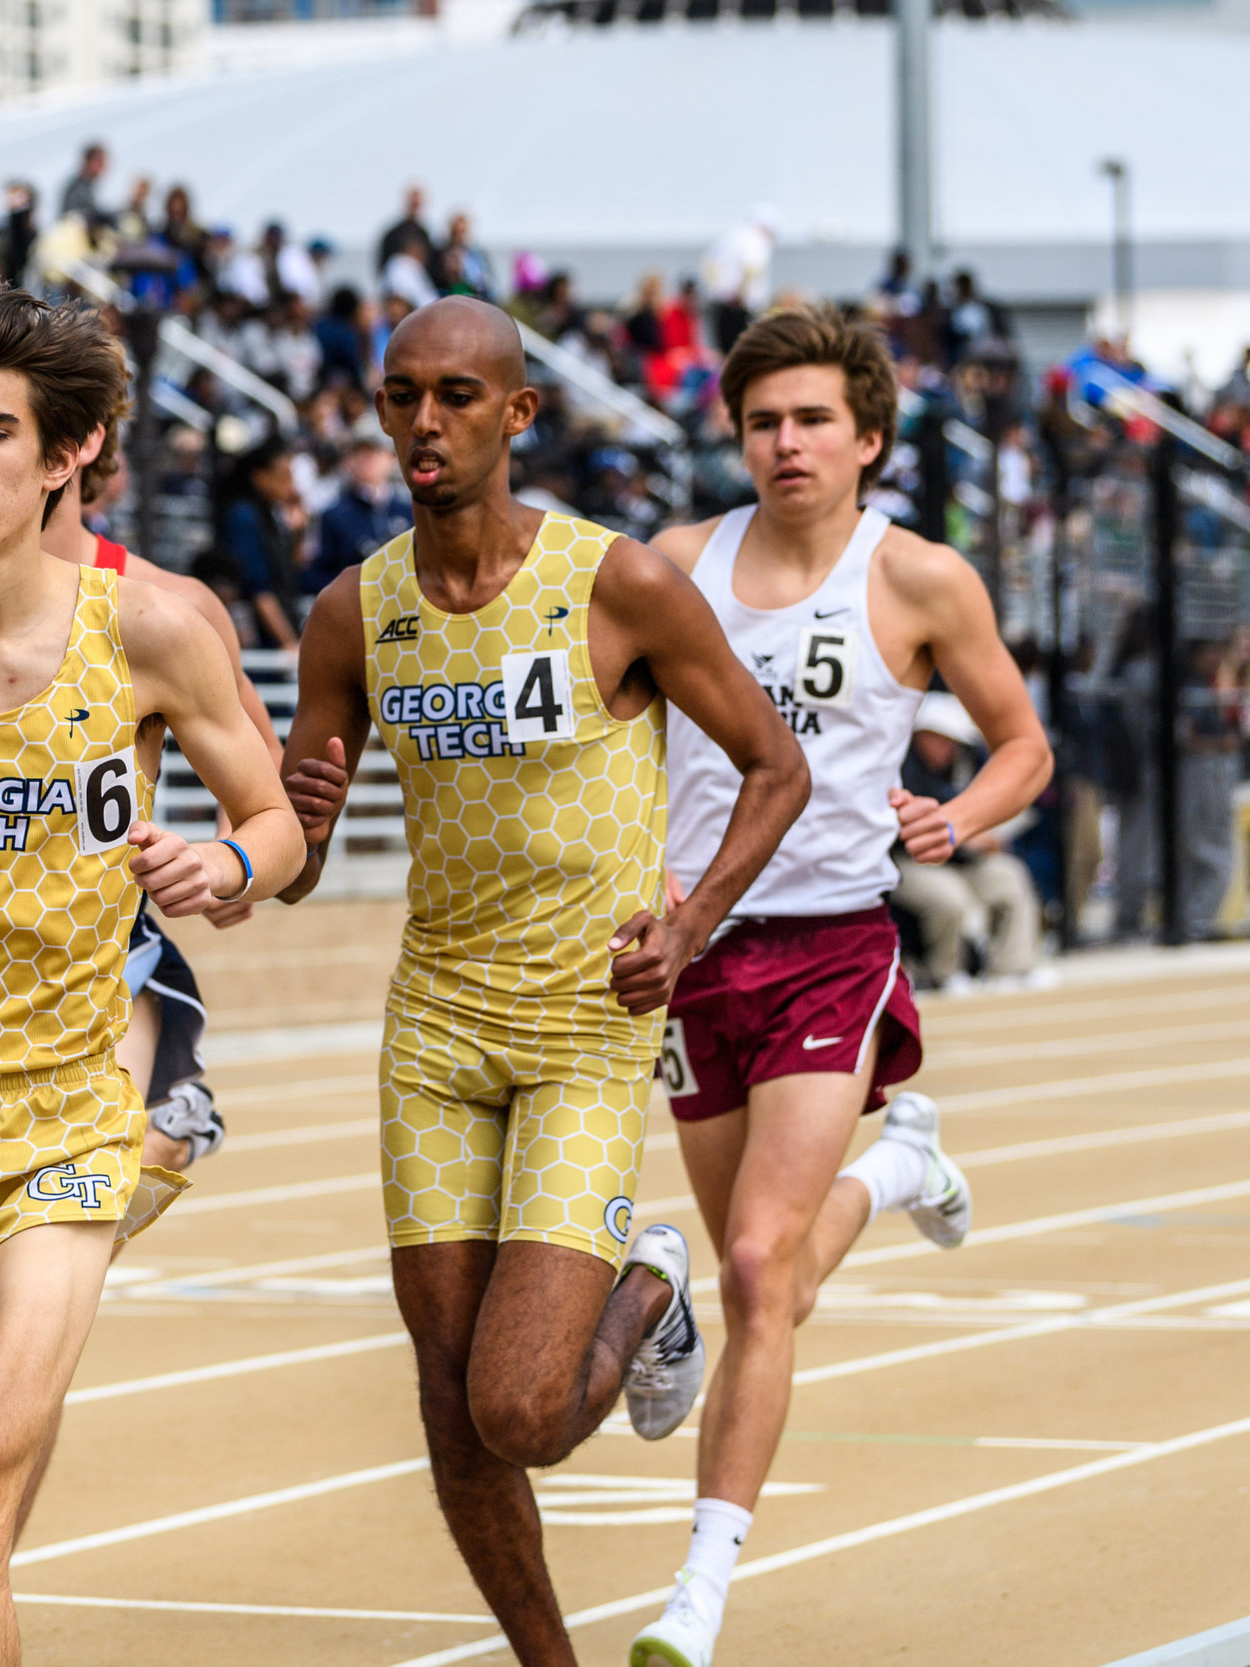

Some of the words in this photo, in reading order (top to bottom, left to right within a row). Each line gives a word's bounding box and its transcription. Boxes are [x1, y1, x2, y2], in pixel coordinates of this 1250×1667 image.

[375, 616, 420, 643] ACC
[514, 657, 563, 732] 4
[803, 635, 844, 699] 5
[86, 758, 132, 844] 6
[27, 1163, 111, 1208] GT
